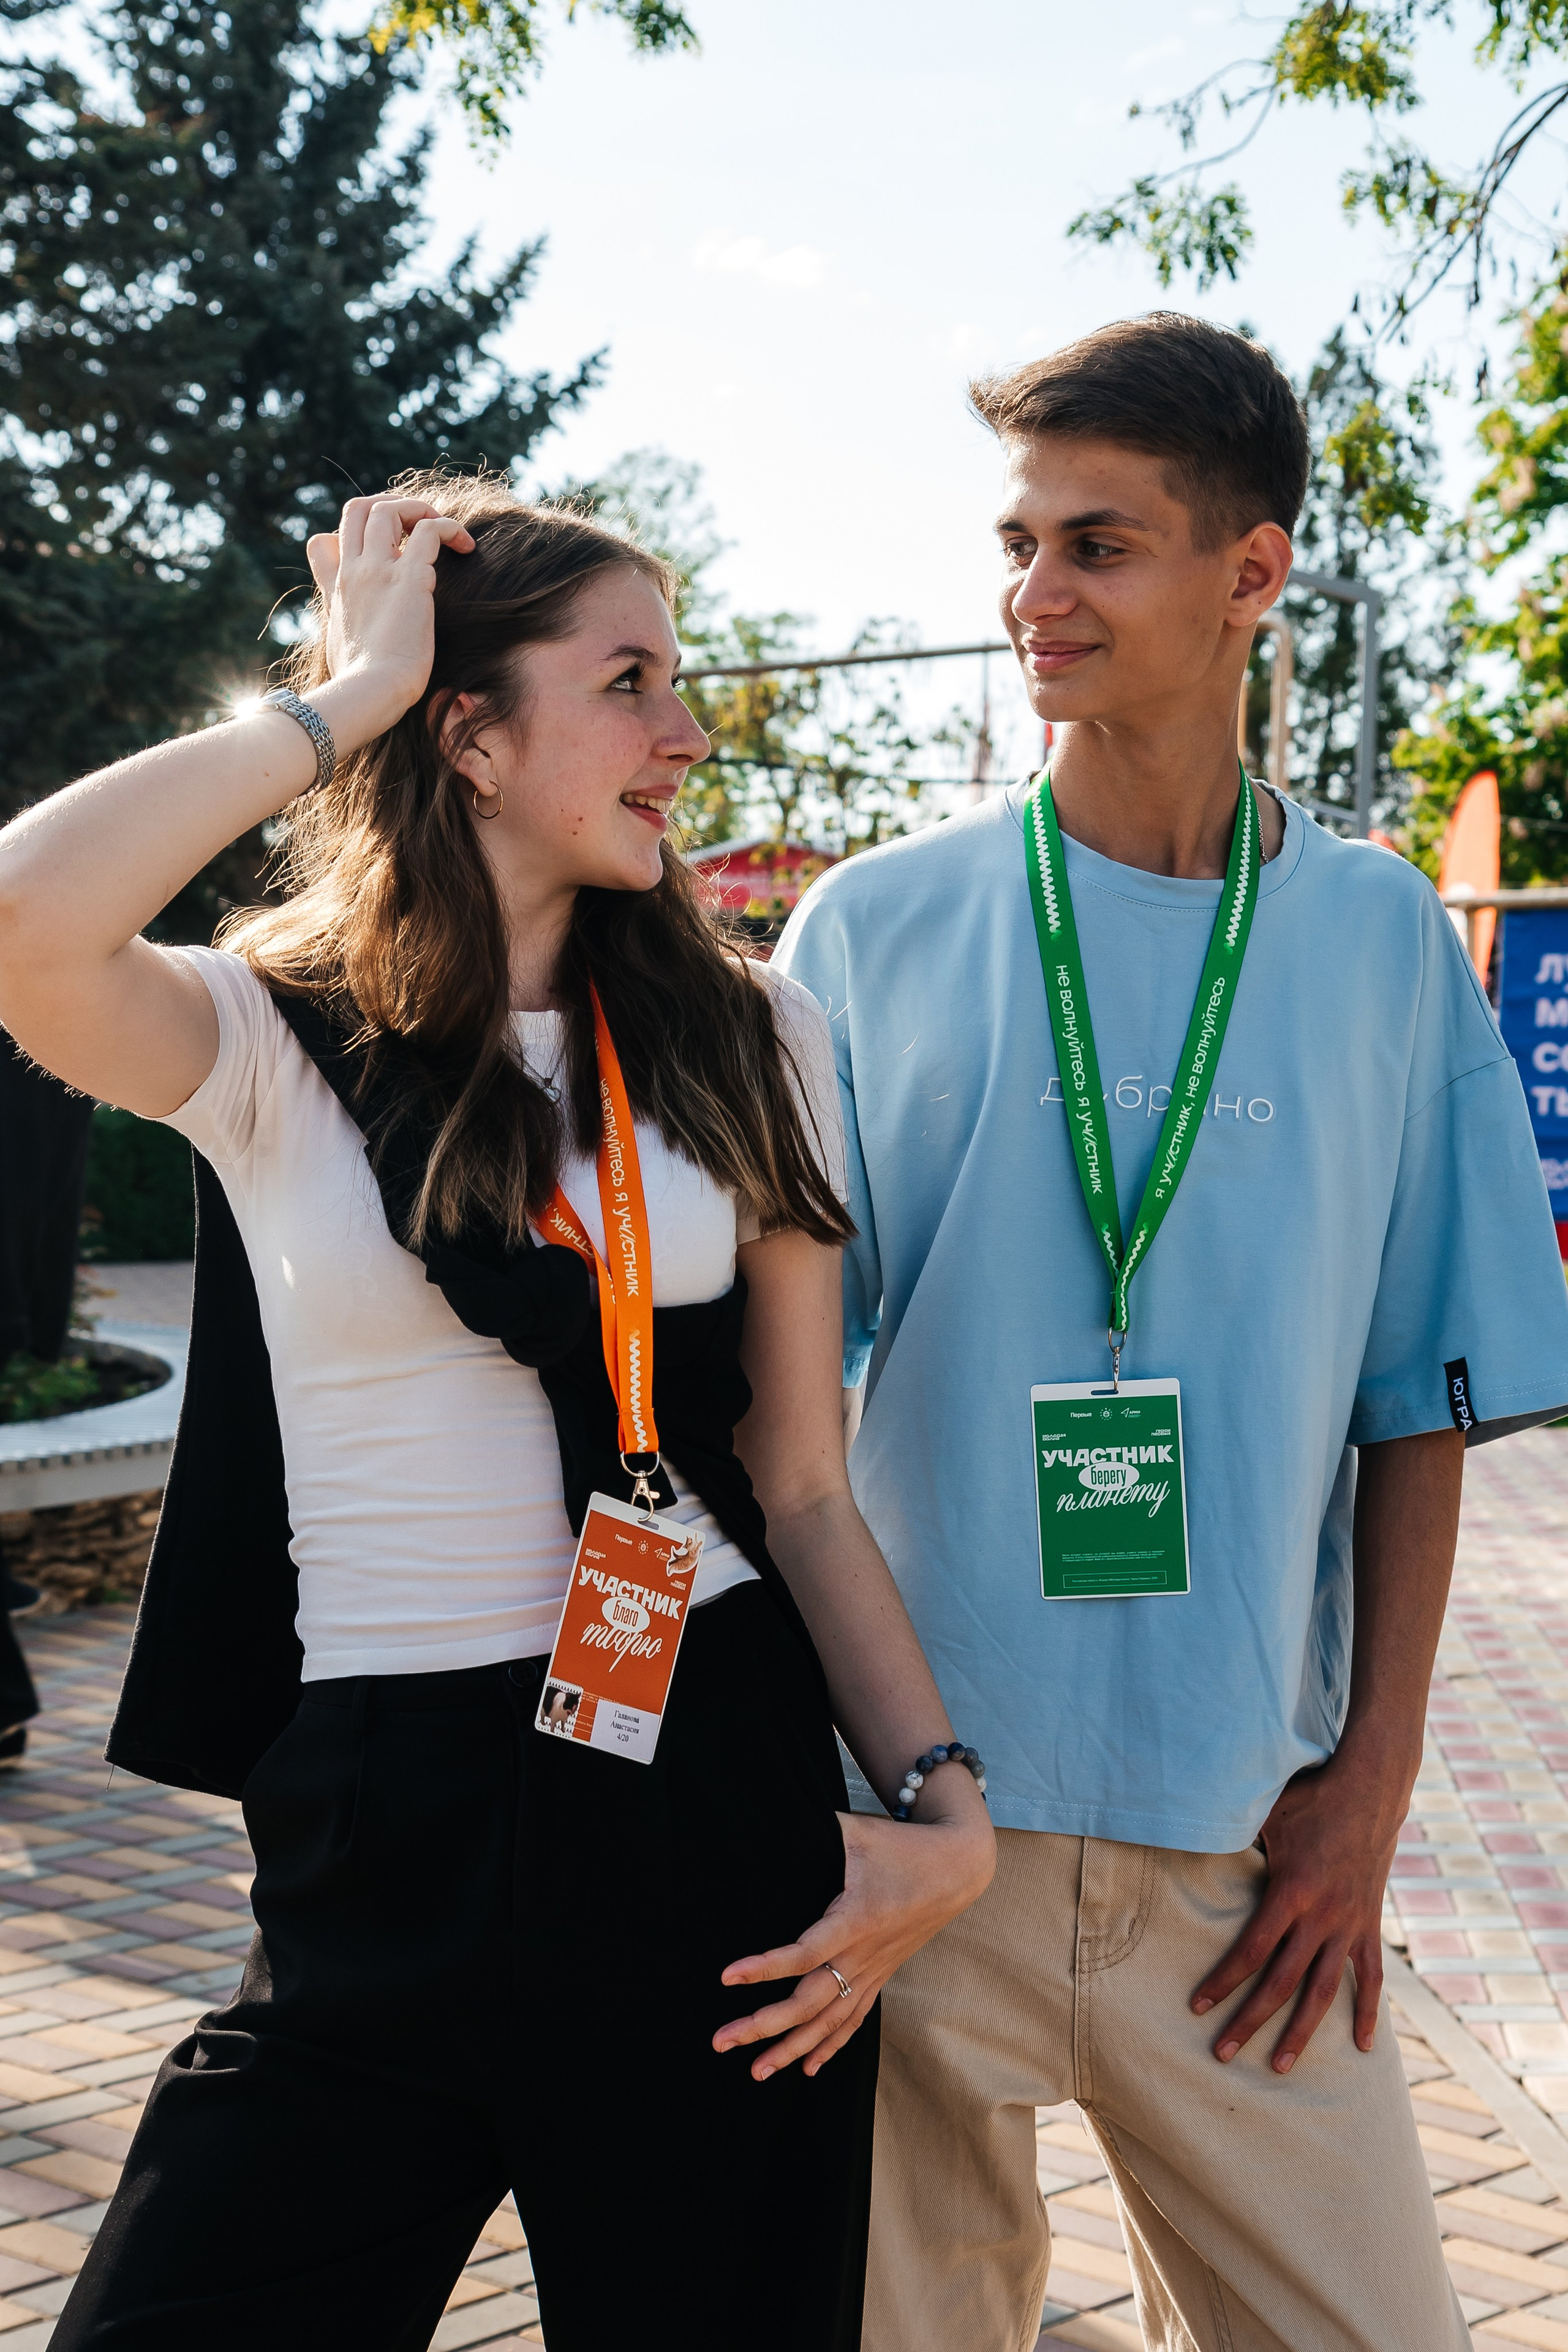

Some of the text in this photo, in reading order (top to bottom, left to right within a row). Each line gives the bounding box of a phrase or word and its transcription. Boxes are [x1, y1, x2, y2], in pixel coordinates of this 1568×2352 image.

[1056, 965, 1070, 987] не
[1192, 976, 1226, 1074] волнуйтесь
[1060, 990, 1086, 1091] волнуйтесь
[600, 1078, 609, 1098] не
[1185, 1075, 1200, 1098] не
[601, 1097, 625, 1187] волнуйтесь
[1453, 1377, 1472, 1431] ЮГРА
[1041, 1444, 1174, 1468] УЧАСТНИК
[1091, 1465, 1126, 1487] берегу
[1057, 1480, 1170, 1518] планету
[578, 1565, 683, 1620] УЧАСТНИК
[612, 1599, 639, 1627] благо
[580, 1623, 662, 1673] творю
[610, 1721, 639, 1734] Анастасия
[614, 1710, 639, 1724] Галанова
[617, 1733, 629, 1742] 4/20
